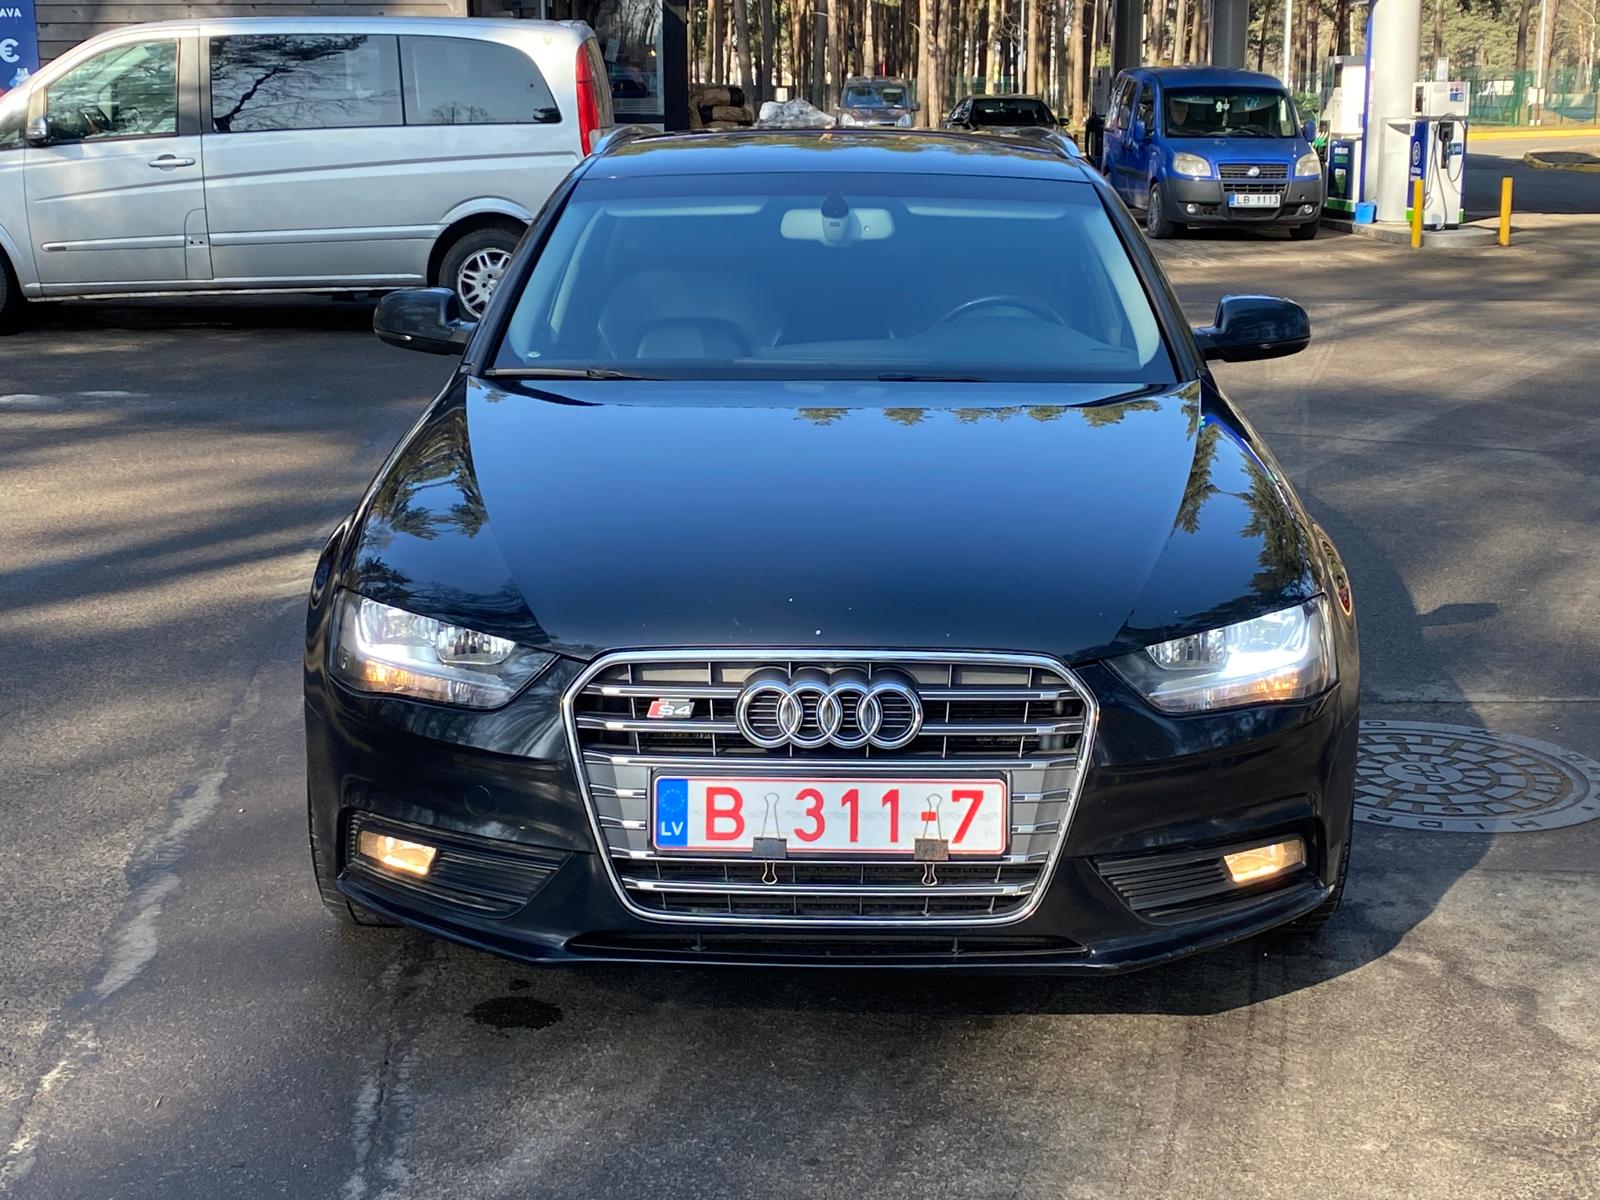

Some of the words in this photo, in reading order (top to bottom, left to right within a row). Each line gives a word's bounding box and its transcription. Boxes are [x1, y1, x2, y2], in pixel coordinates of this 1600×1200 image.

[658, 705, 691, 716] S4
[706, 787, 745, 841] B
[661, 821, 684, 836] LV
